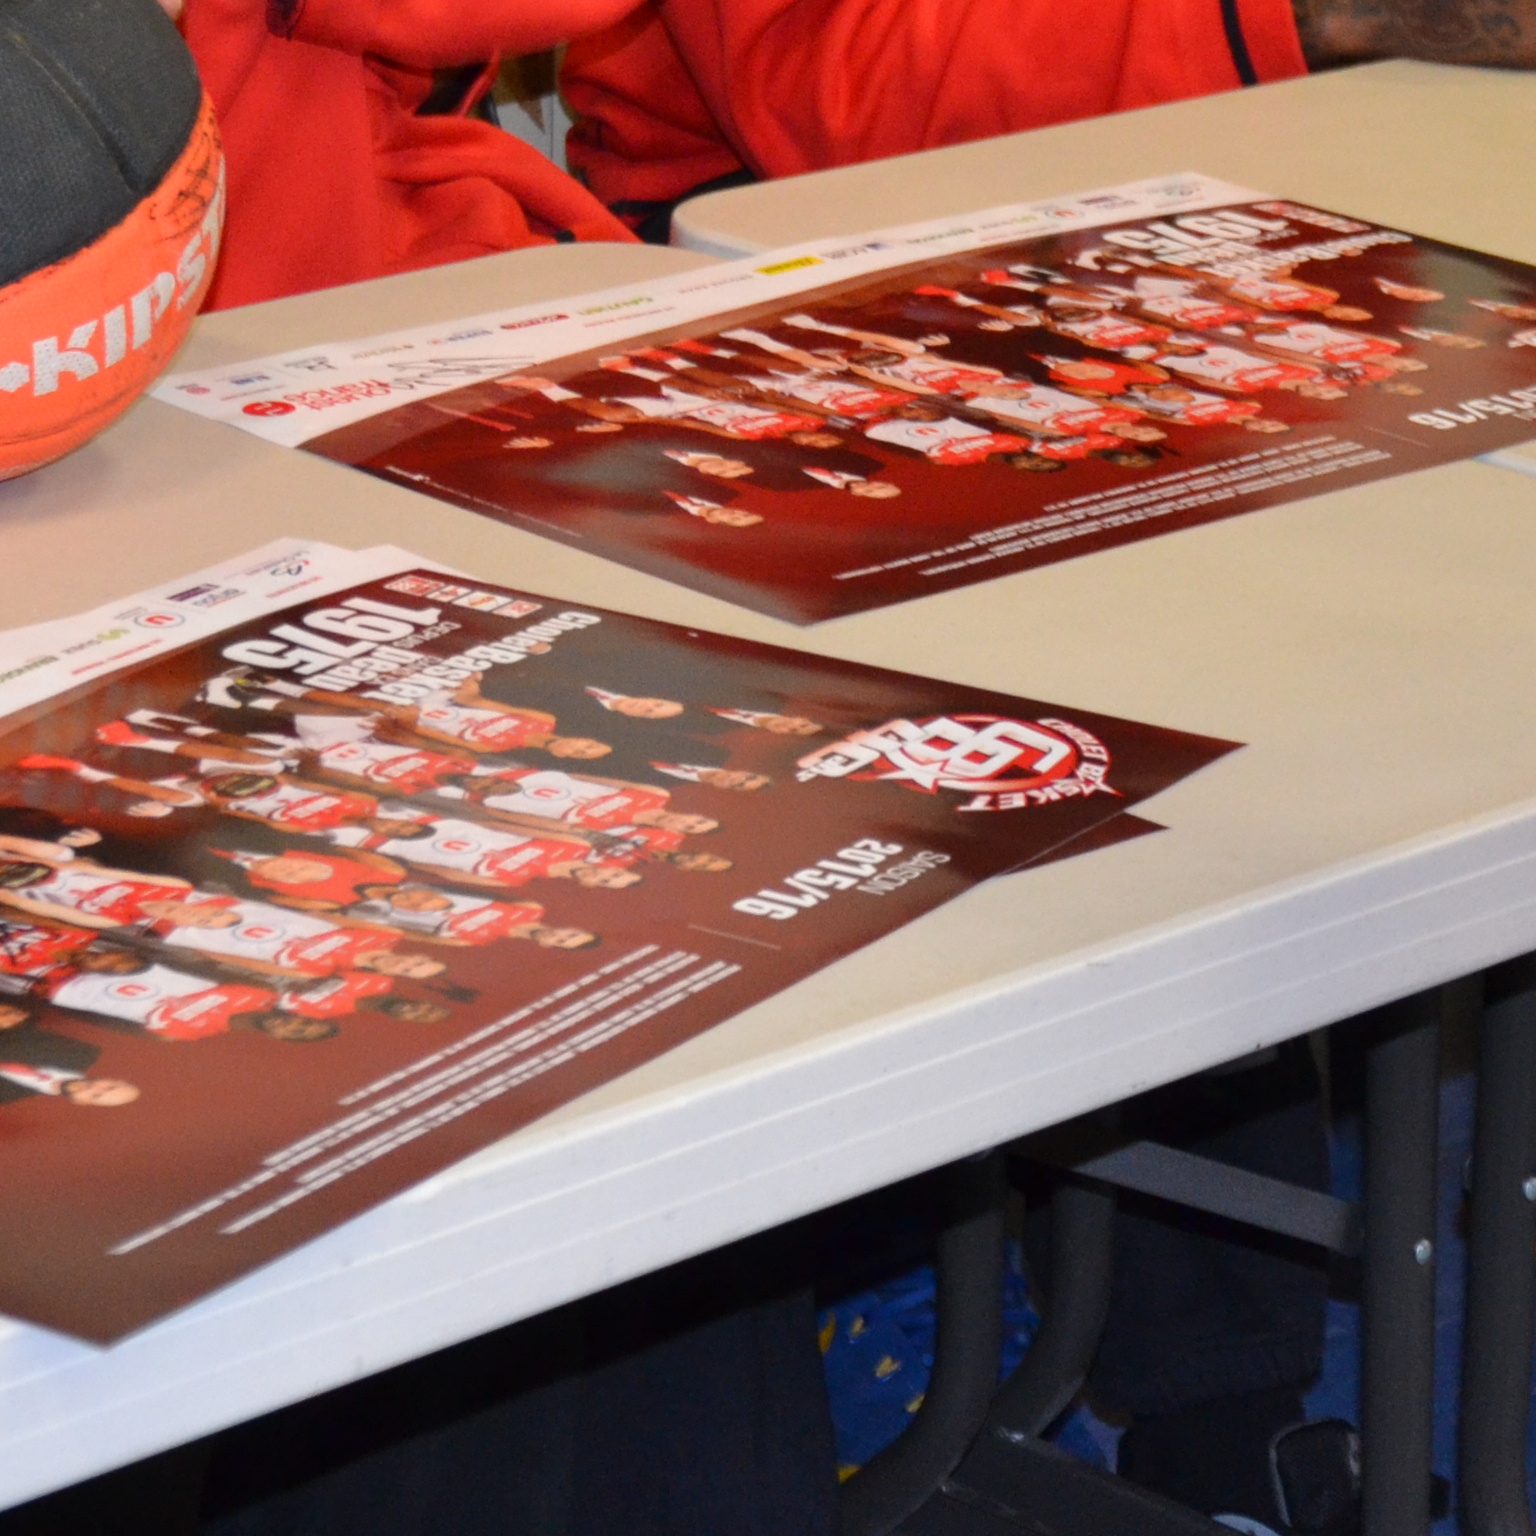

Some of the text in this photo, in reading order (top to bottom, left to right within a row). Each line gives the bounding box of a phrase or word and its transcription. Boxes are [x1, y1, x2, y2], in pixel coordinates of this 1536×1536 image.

[1100, 208, 1290, 255] 1975
[220, 595, 443, 677] 1975
[301, 645, 422, 692] peau
[955, 761, 1106, 812] BASKET
[731, 836, 904, 921] 2015/16
[854, 849, 952, 896] SAISON
